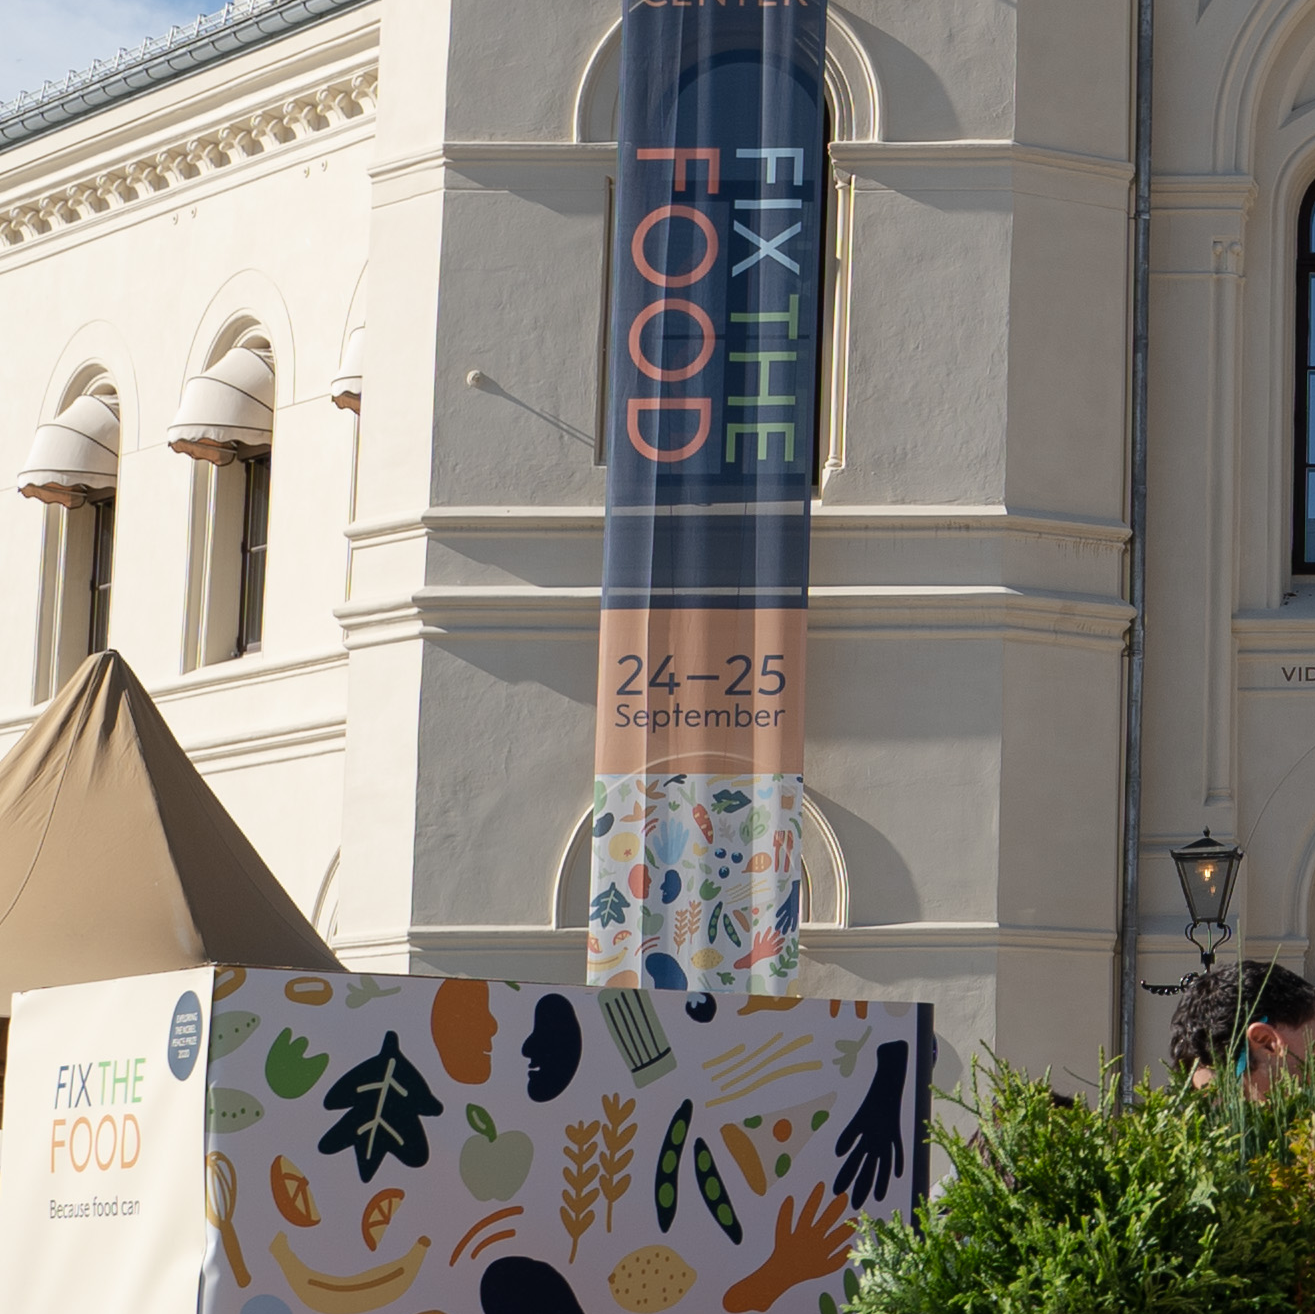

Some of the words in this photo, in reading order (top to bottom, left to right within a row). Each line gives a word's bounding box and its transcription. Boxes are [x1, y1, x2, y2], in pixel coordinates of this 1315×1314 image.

[731, 148, 804, 277] FIX
[627, 148, 720, 463] FOOD
[726, 294, 799, 463] THE
[615, 703, 785, 733] September
[55, 1062, 93, 1109] FIX
[98, 1057, 146, 1105] THE
[51, 1113, 141, 1173] FOOD
[50, 1199, 90, 1219] Because
[93, 1196, 118, 1217] food
[121, 1199, 140, 1216] can
